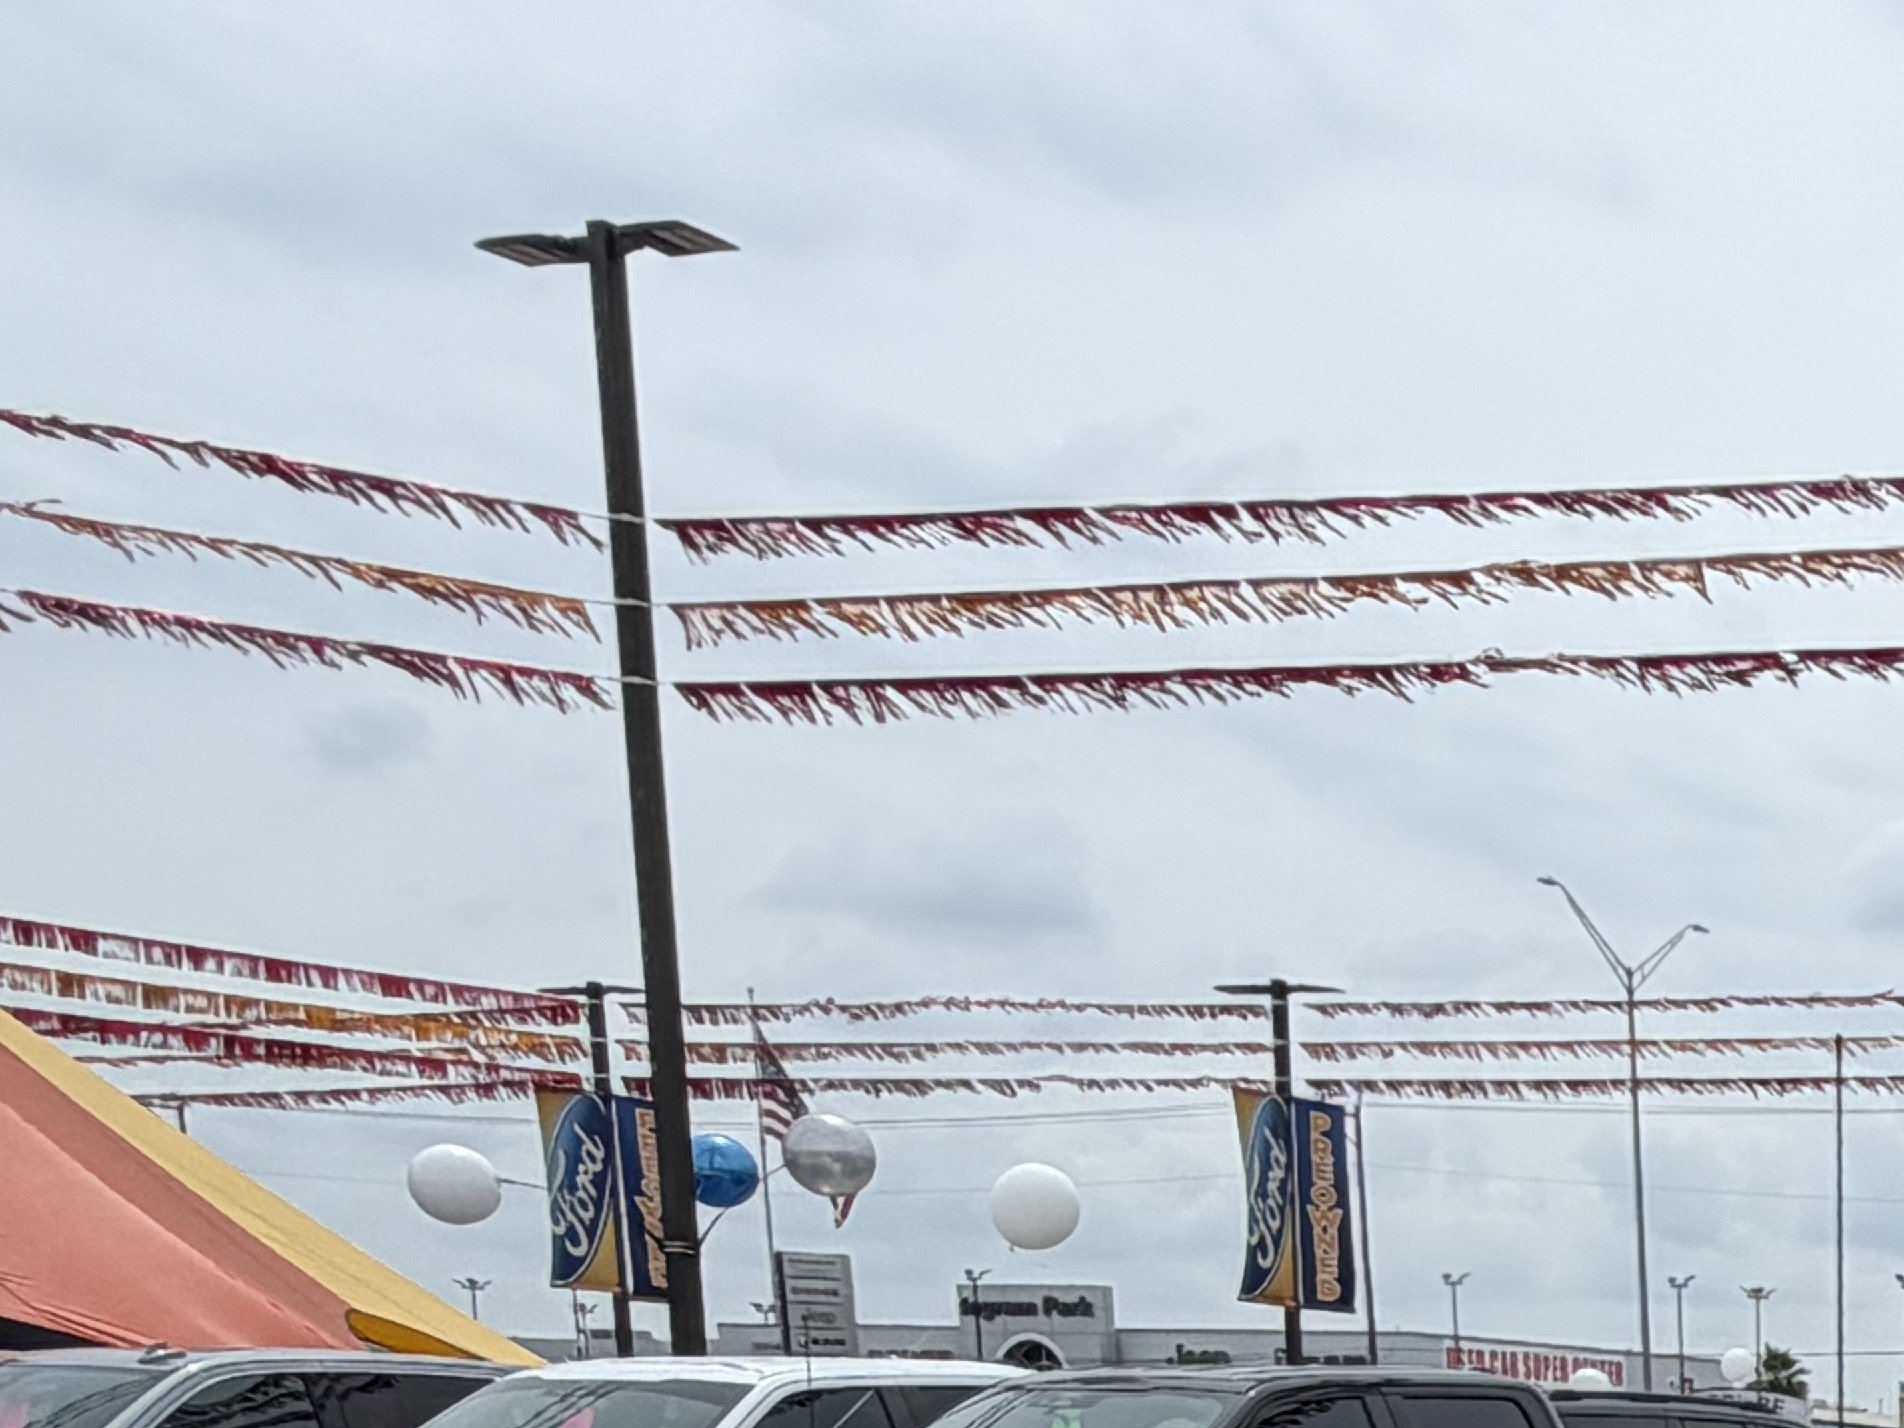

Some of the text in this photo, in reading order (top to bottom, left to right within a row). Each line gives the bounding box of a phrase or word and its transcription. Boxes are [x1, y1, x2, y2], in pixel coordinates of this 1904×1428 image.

[551, 1121, 606, 1257] Ford
[1248, 1125, 1288, 1270] Ford
[1489, 1349, 1520, 1379] CAR
[1522, 1350, 1570, 1384] SUPER
